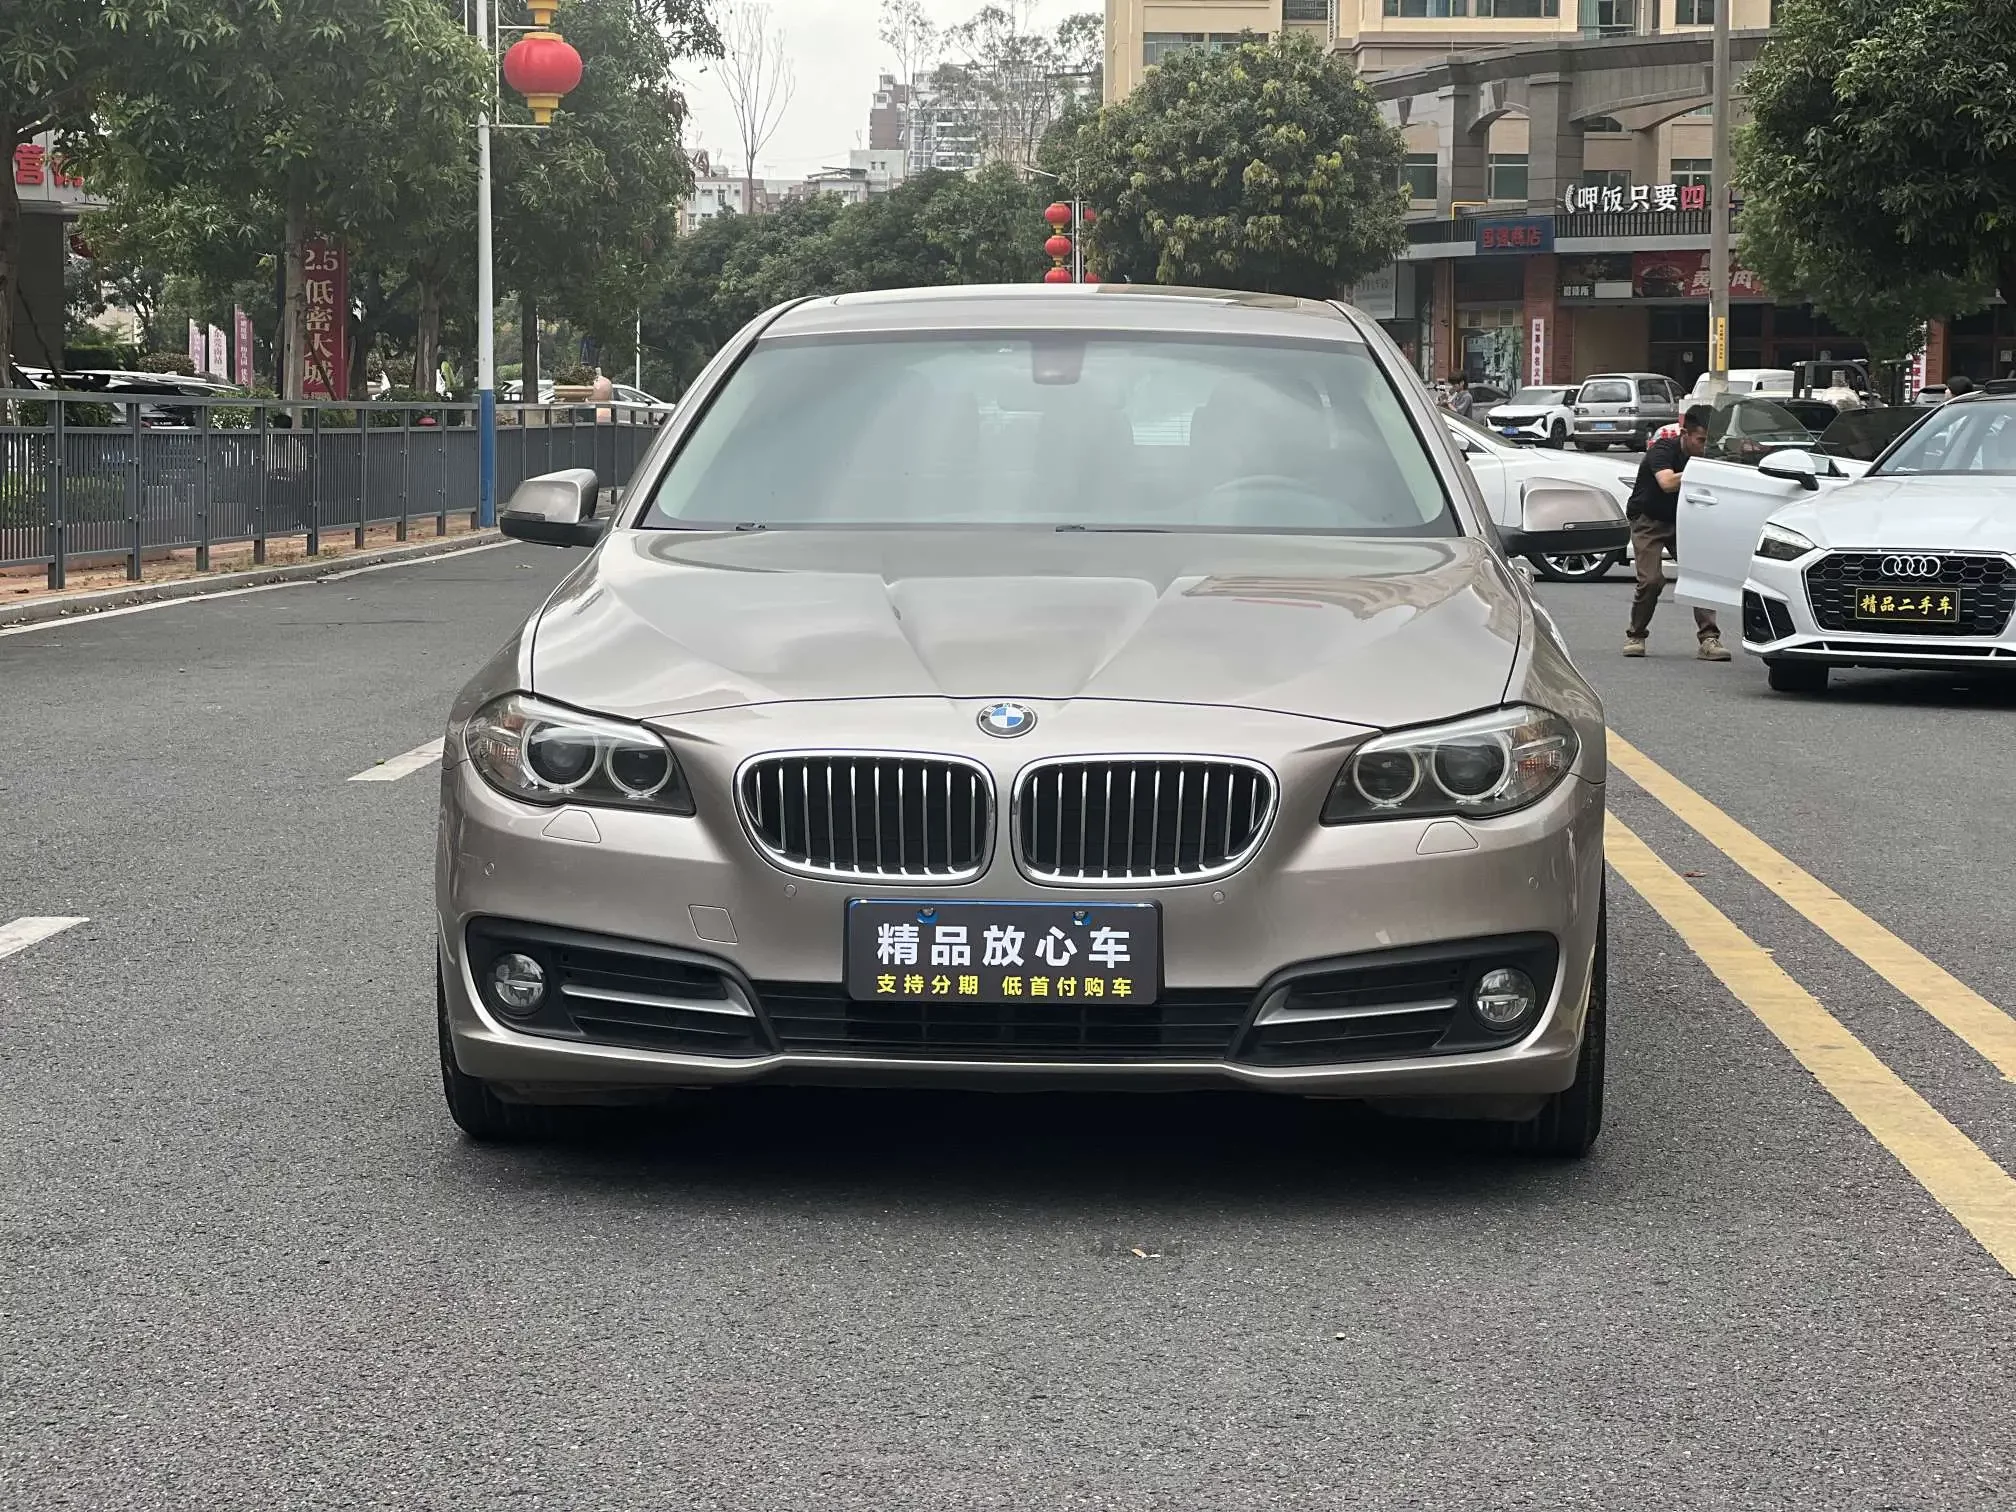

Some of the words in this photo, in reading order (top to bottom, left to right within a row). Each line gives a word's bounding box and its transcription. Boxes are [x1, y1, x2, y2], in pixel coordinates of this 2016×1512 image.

[304, 250, 339, 271] 2.5
[303, 279, 334, 385] 低密大城
[1860, 594, 1953, 615] 精品二手车
[877, 923, 1131, 968] 精品放心车
[877, 974, 979, 995] 支持分期
[1002, 975, 1132, 997] 低首付购车
